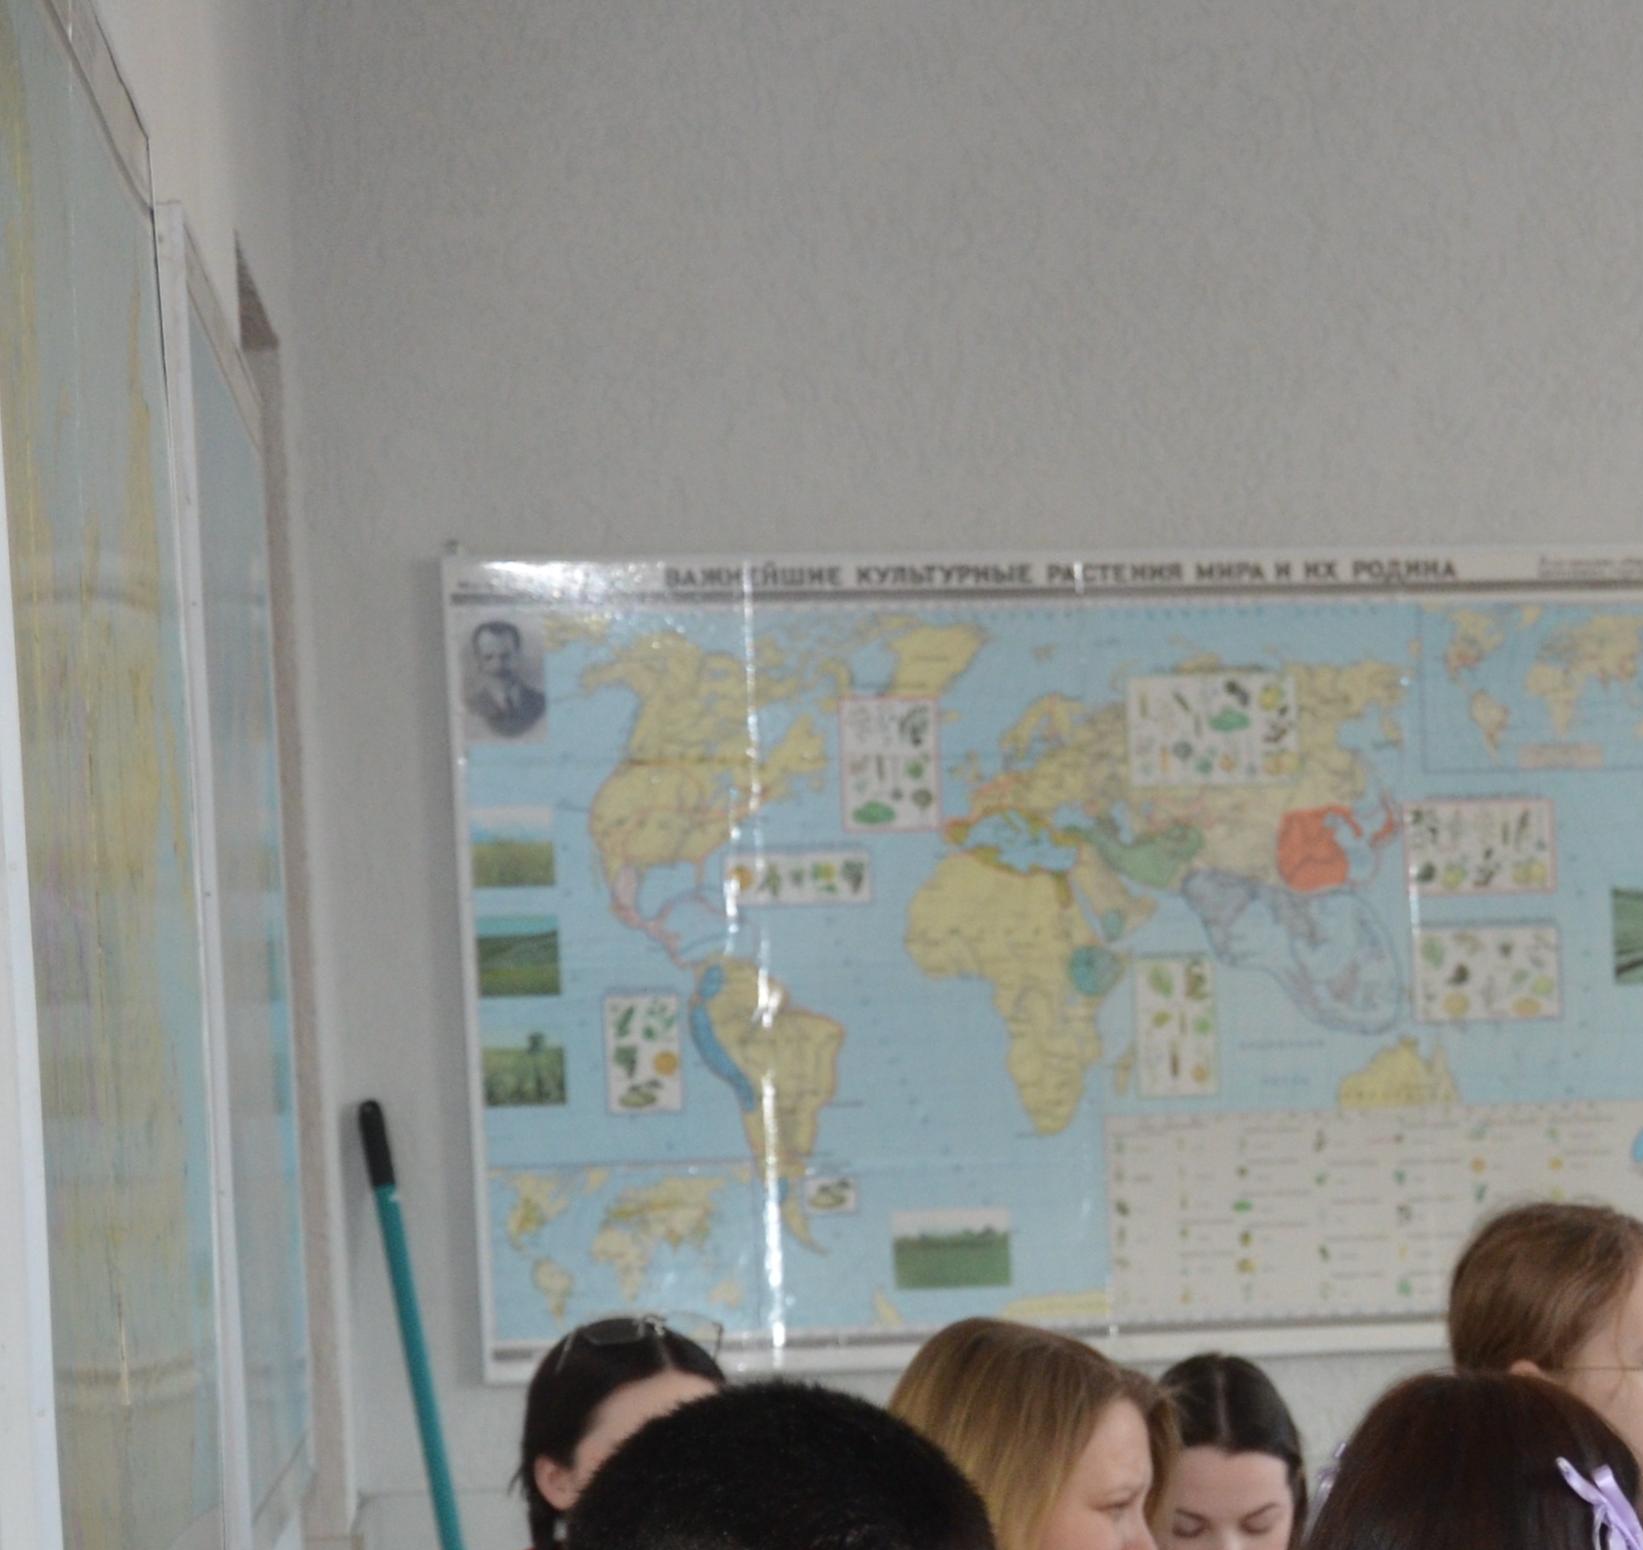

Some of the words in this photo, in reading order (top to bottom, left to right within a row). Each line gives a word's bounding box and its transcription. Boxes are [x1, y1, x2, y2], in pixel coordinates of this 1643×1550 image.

[663, 561, 841, 587] ВАЖНЕЙШИЕ
[855, 564, 1033, 585] КУЛЬТУРНЫЕ
[1047, 562, 1183, 583] РАСТЕНИЯ
[1195, 562, 1265, 580] МИРА
[1275, 562, 1291, 578] И
[1304, 561, 1337, 578] ИХ
[1352, 560, 1456, 581] РОДИНА
